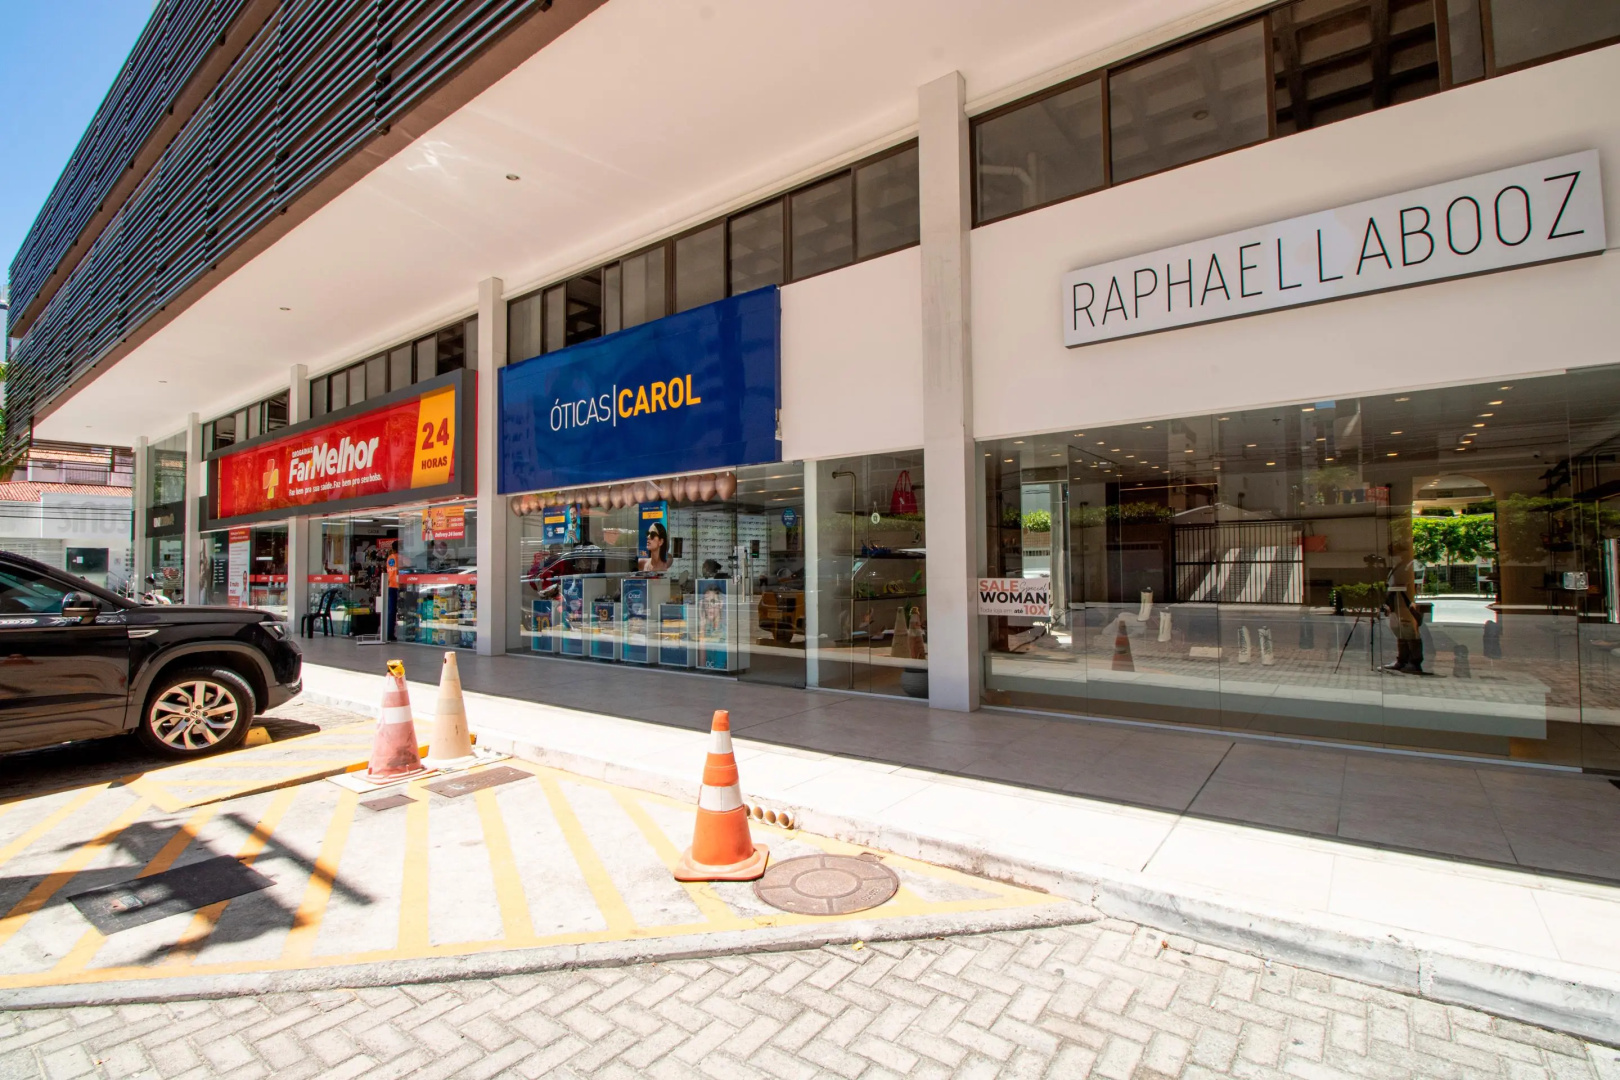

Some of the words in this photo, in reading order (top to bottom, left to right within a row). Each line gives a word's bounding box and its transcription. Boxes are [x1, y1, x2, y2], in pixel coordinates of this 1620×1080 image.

[550, 394, 611, 431] ÓTICAS
[618, 374, 701, 418] CAROL
[422, 417, 450, 450] 24
[288, 436, 379, 484] FarMelhor
[421, 455, 448, 470] HORAS
[980, 580, 1018, 592] SALE
[980, 592, 1047, 604] WOMAN
[1024, 605, 1046, 615] 10X
